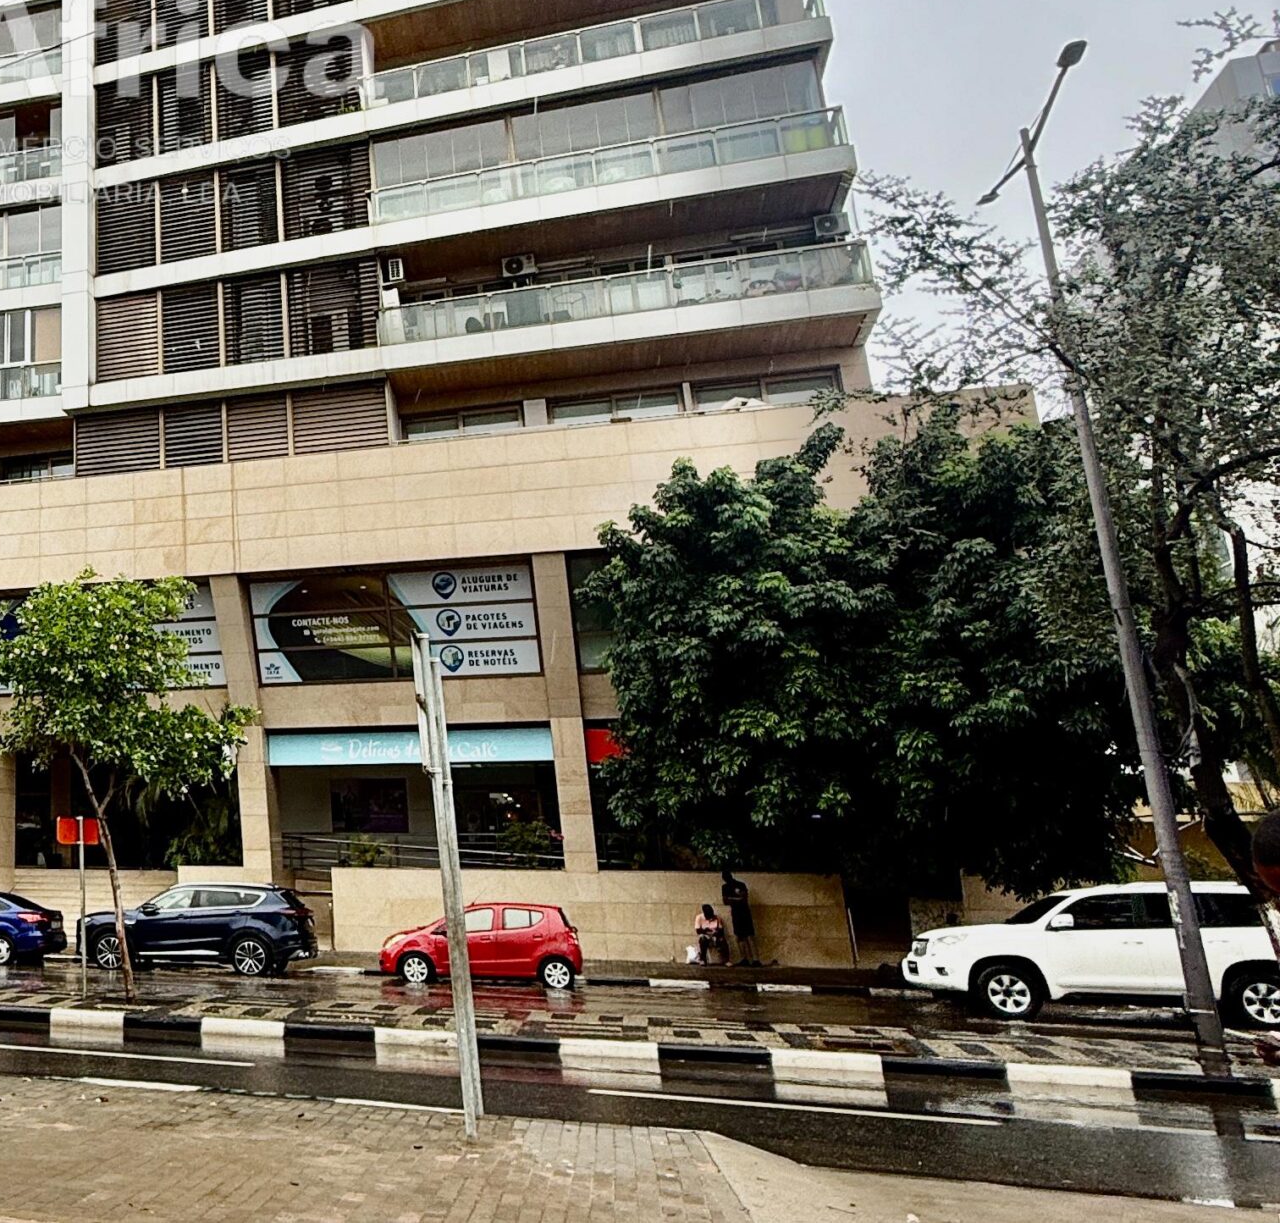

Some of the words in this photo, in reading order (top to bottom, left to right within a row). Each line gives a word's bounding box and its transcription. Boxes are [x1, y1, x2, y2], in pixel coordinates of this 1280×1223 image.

[461, 574, 503, 584] ALUGUER
[506, 573, 518, 582] DE
[461, 583, 509, 593] VIATURAS
[291, 615, 350, 627] CONTACTE-NOS
[465, 613, 507, 621] PACOTES
[466, 622, 478, 630] DE
[481, 621, 524, 630] VIAGENS
[467, 648, 515, 658] RESERVAS
[483, 656, 518, 666] HOTÉIS
